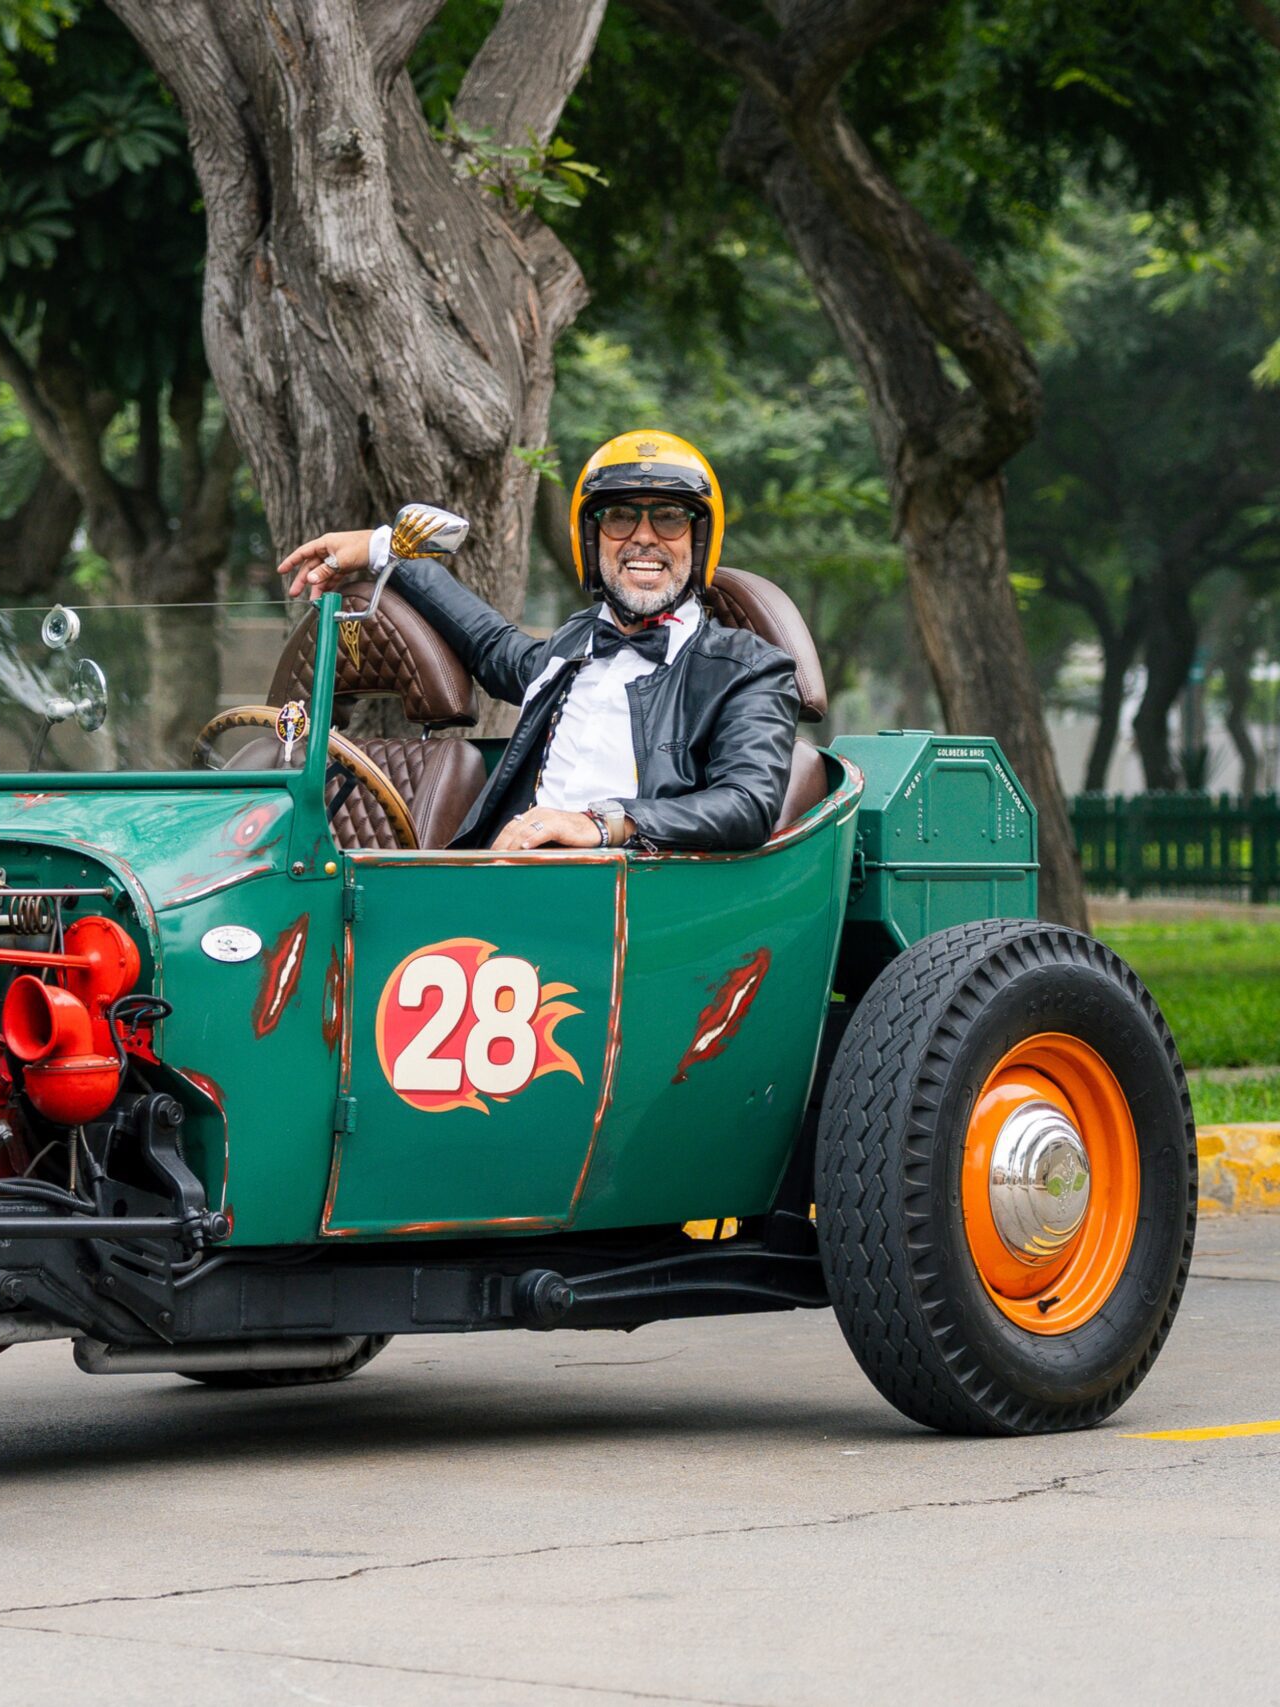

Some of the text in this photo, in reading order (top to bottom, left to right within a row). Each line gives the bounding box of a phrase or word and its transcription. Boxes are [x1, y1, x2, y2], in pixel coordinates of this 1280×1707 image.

[937, 748, 985, 758] GOLDBERG BROS
[904, 770, 922, 799] MFG BY
[994, 763, 1013, 793] DENVER
[1011, 792, 1025, 813] COLO
[392, 954, 541, 1096] 28
